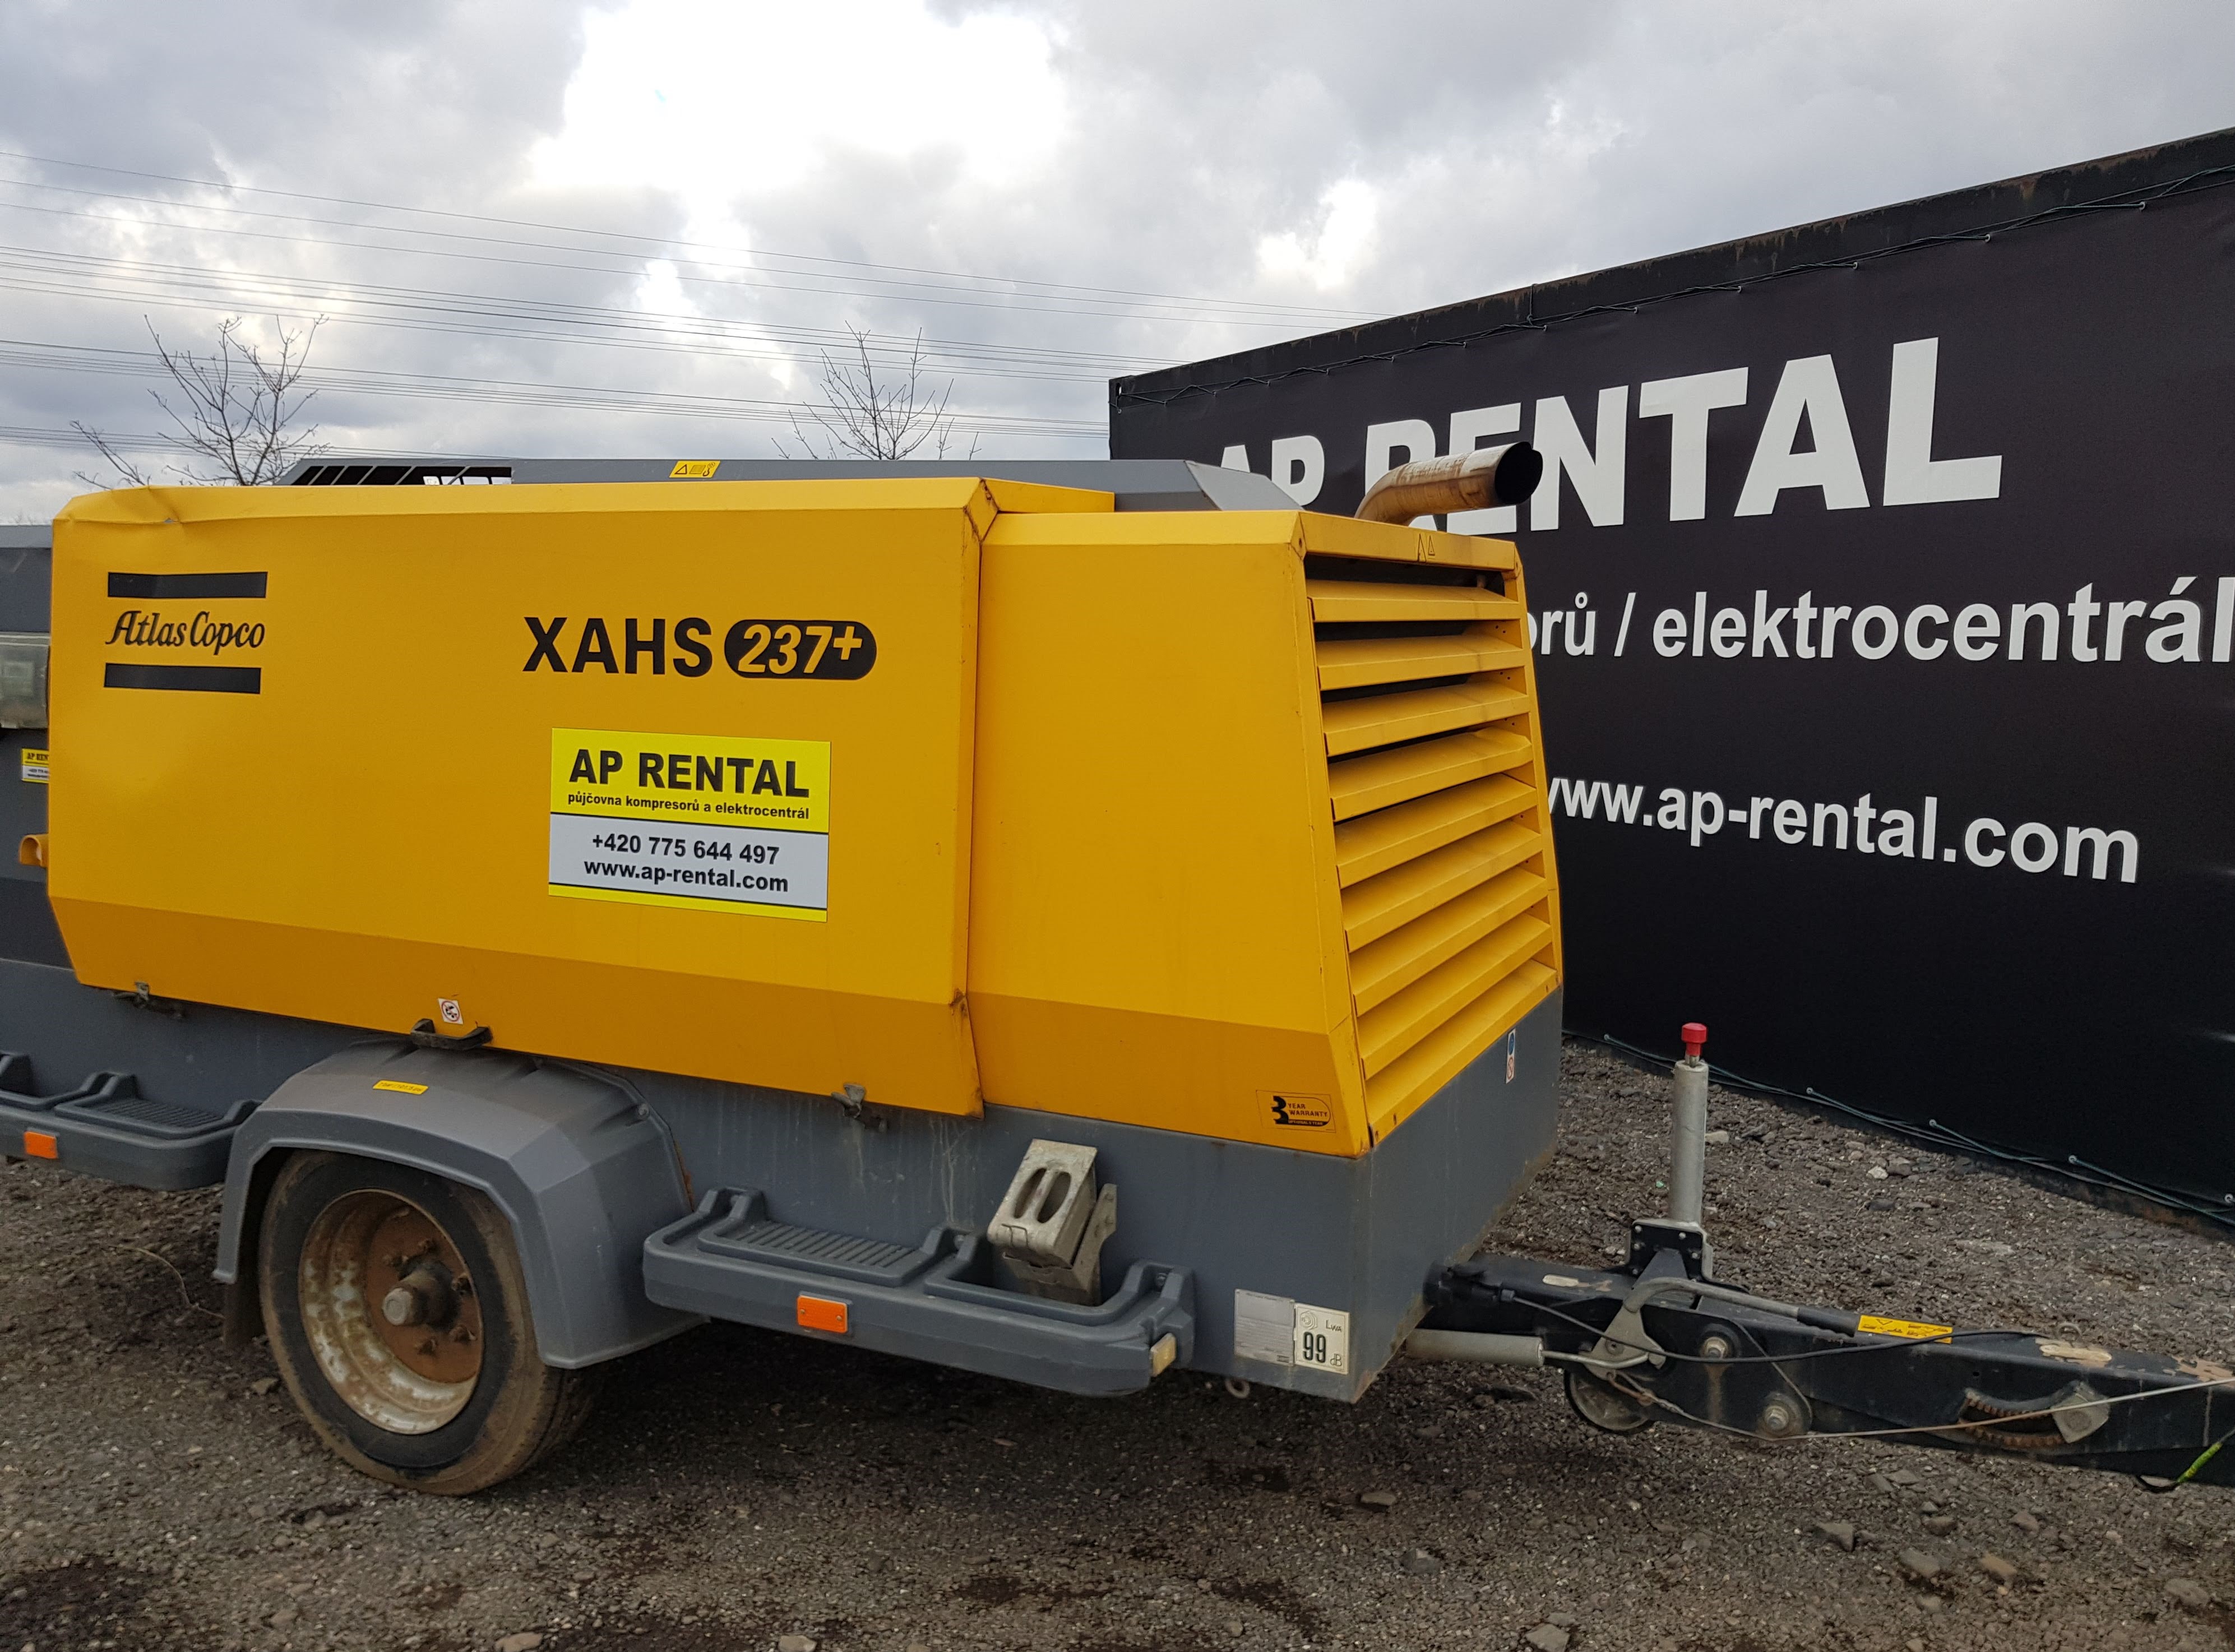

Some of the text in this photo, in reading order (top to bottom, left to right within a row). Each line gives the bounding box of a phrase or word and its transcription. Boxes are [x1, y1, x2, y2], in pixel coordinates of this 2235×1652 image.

[1220, 435, 1325, 506] P
[105, 610, 266, 655] Atlas Copco
[1527, 592, 1596, 656] rů
[1653, 576, 2235, 663] elektrocentrál
[522, 617, 863, 677] XAHS 237+
[569, 749, 809, 798] AP RENTAL
[568, 791, 809, 819] půjčovna kompresorů a elektrocentrál
[593, 834, 780, 865] +420 775 644 497
[584, 861, 788, 892] www.ap-rental.com
[1303, 1331, 1326, 1363] 99
[1330, 1353, 1343, 1366] dB
